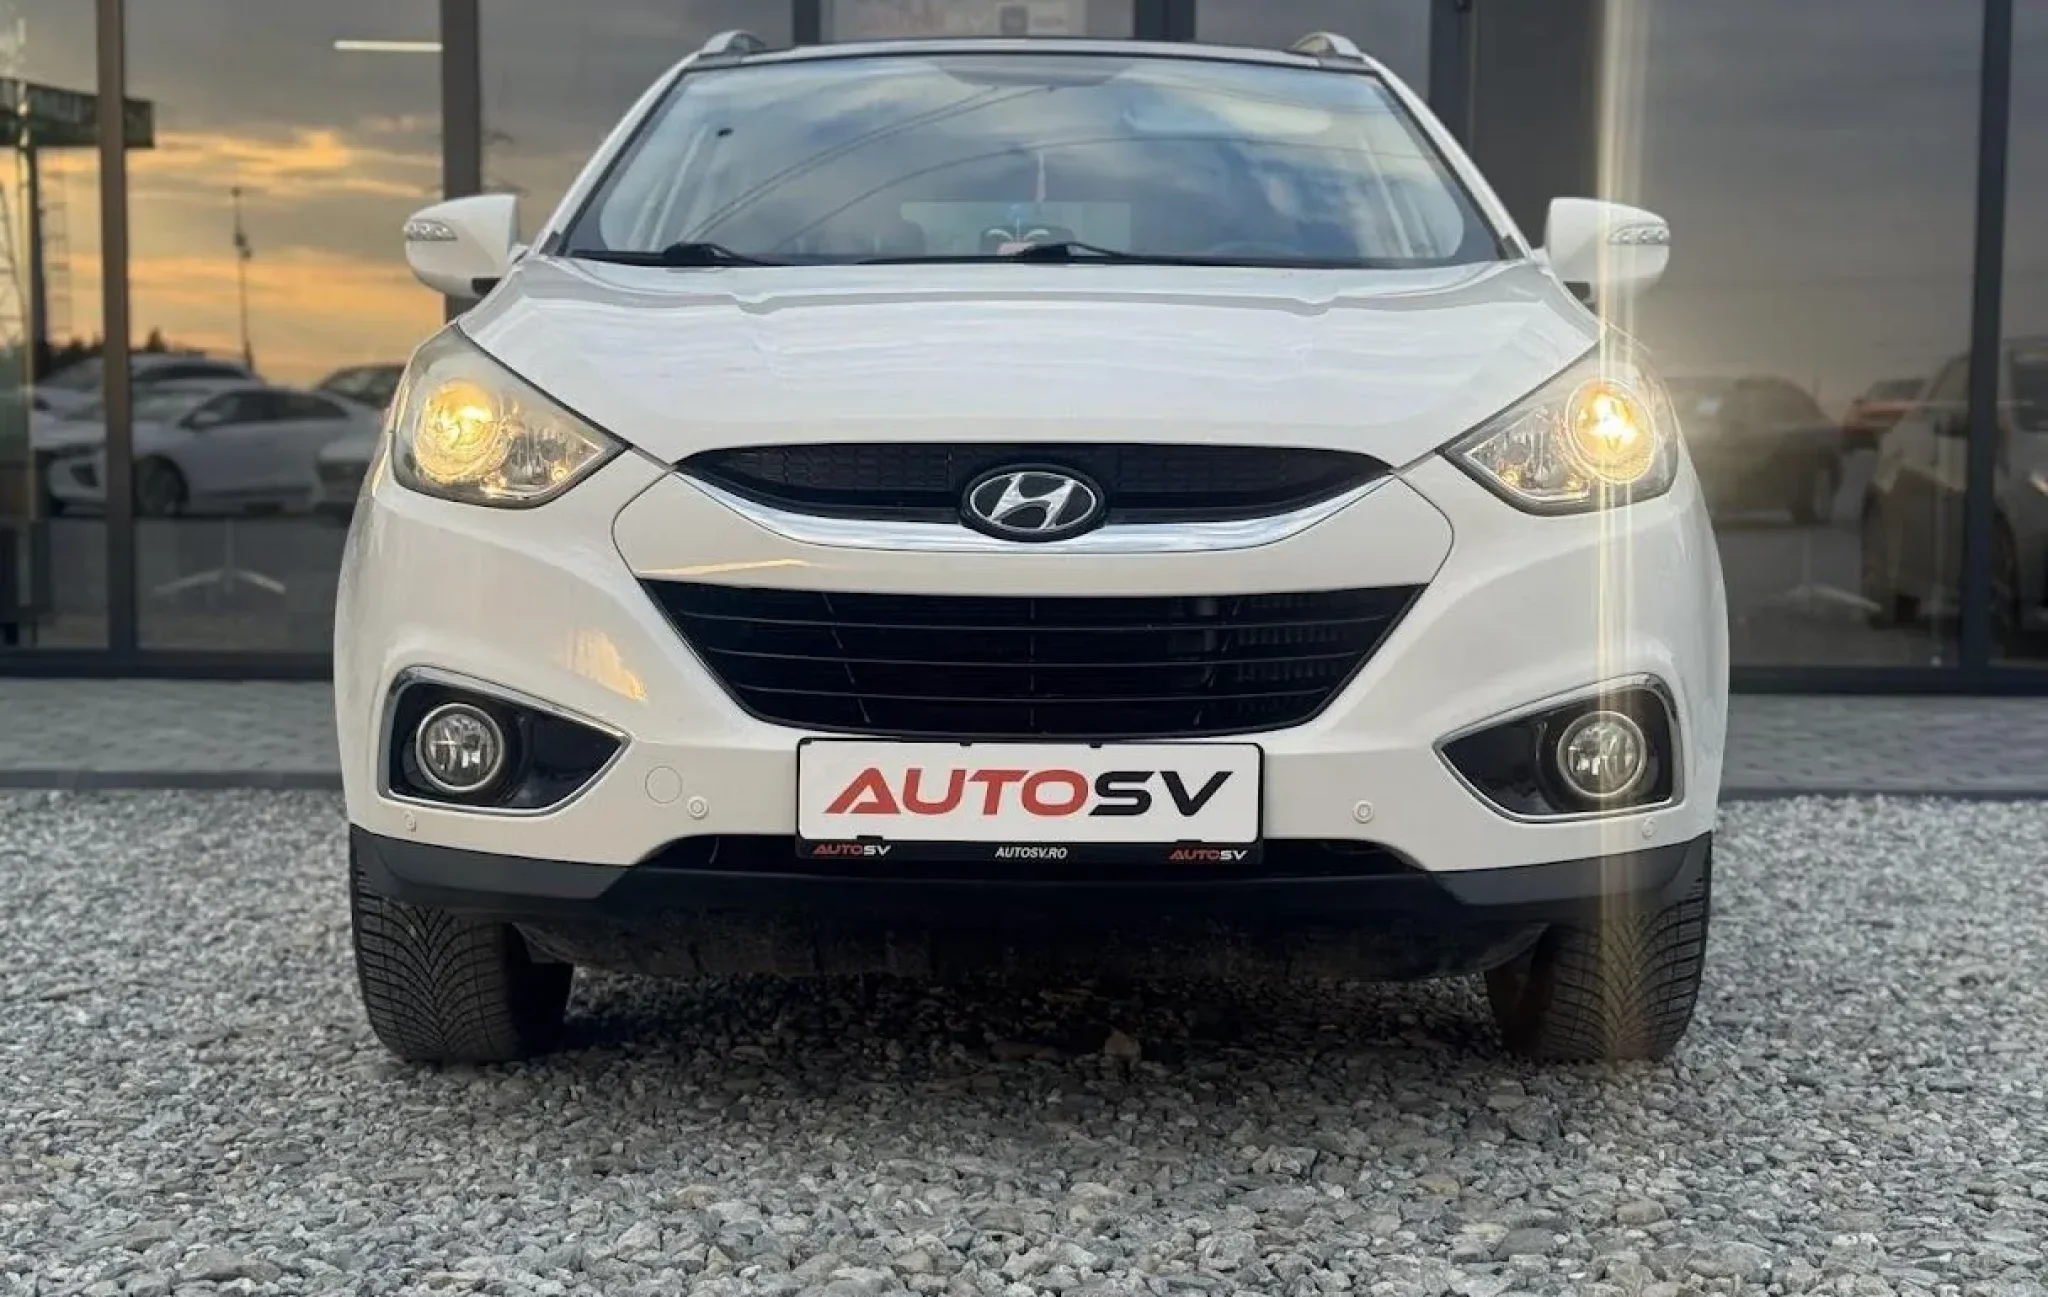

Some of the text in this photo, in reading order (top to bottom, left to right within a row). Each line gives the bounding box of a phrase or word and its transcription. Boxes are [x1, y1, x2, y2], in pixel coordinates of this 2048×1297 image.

[825, 767, 1234, 817] AUTOSV
[813, 843, 892, 857] AUTOSV
[995, 846, 1068, 860] AUTOSV.RO
[1170, 849, 1248, 861] AUTOSV
